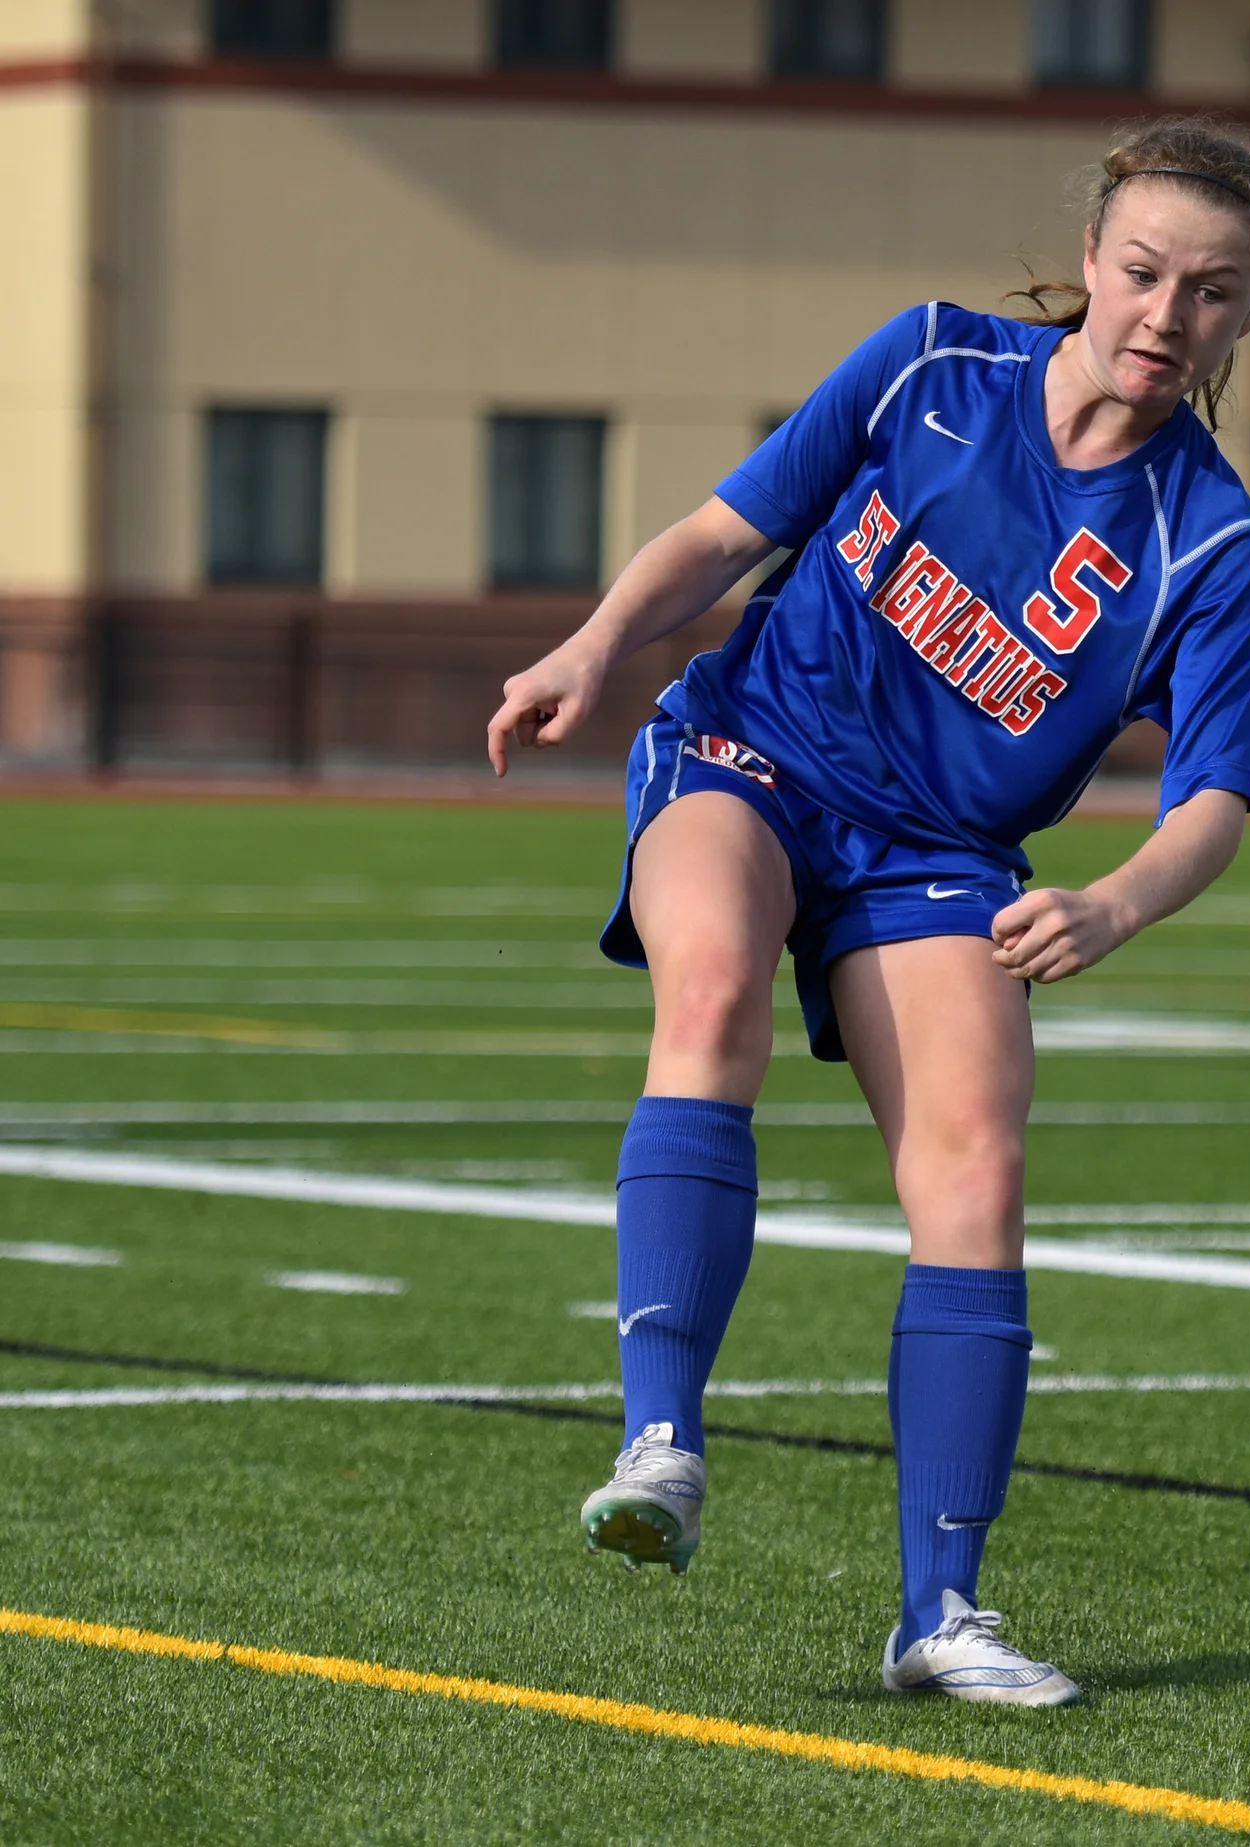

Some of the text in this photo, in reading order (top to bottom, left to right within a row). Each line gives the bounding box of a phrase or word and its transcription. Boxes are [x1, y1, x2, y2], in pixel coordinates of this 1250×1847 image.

[836, 488, 1068, 737] ST. IGNATIUS
[1022, 526, 1134, 655] 5
